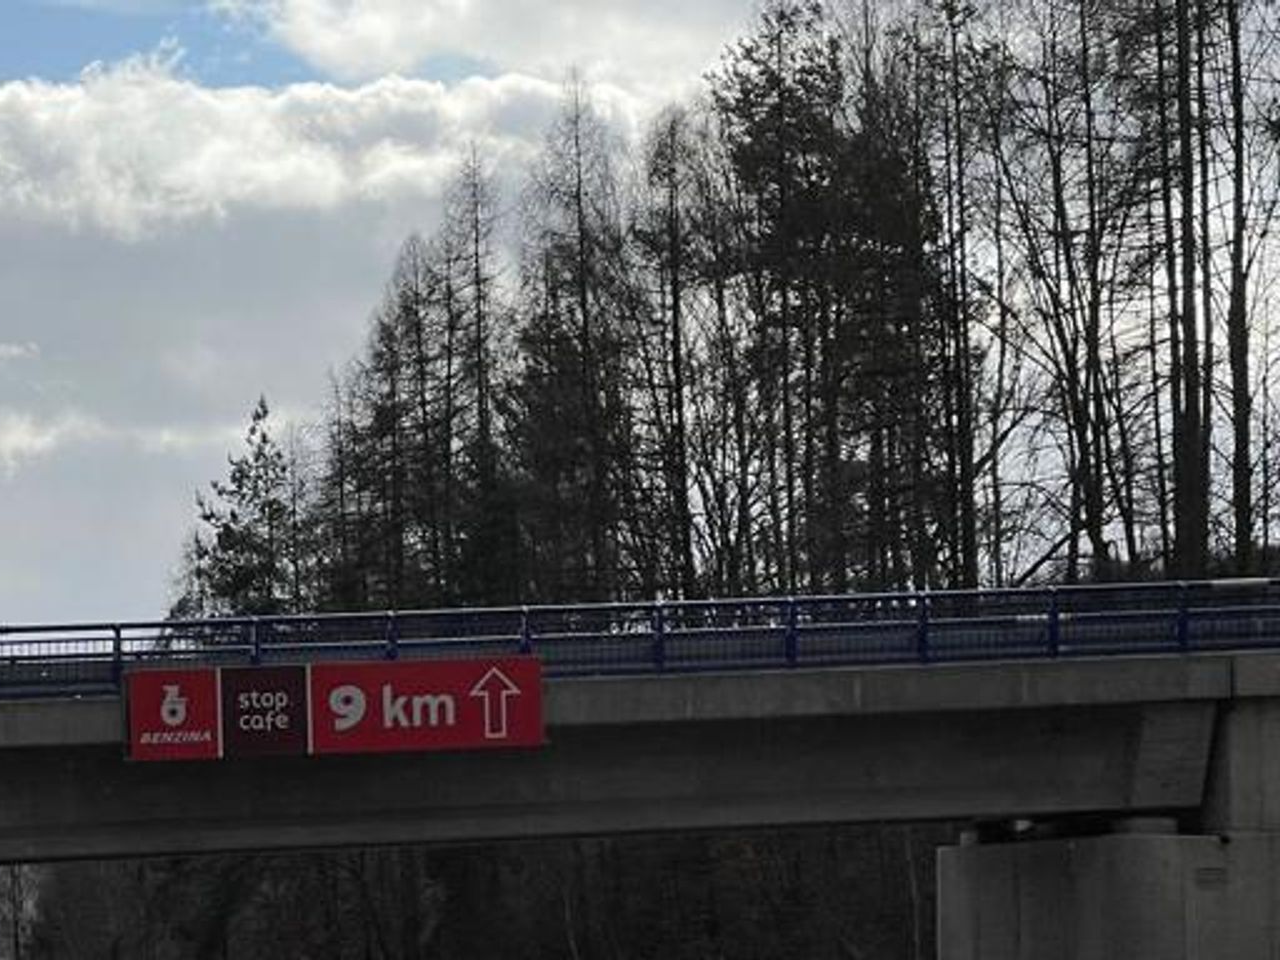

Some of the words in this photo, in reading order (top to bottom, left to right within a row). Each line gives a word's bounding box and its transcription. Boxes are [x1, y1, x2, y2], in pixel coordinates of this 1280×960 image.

[239, 691, 288, 710] stop
[329, 685, 367, 732] 9
[382, 682, 455, 729] km
[239, 711, 289, 731] cafe
[140, 730, 212, 744] BENZINA
